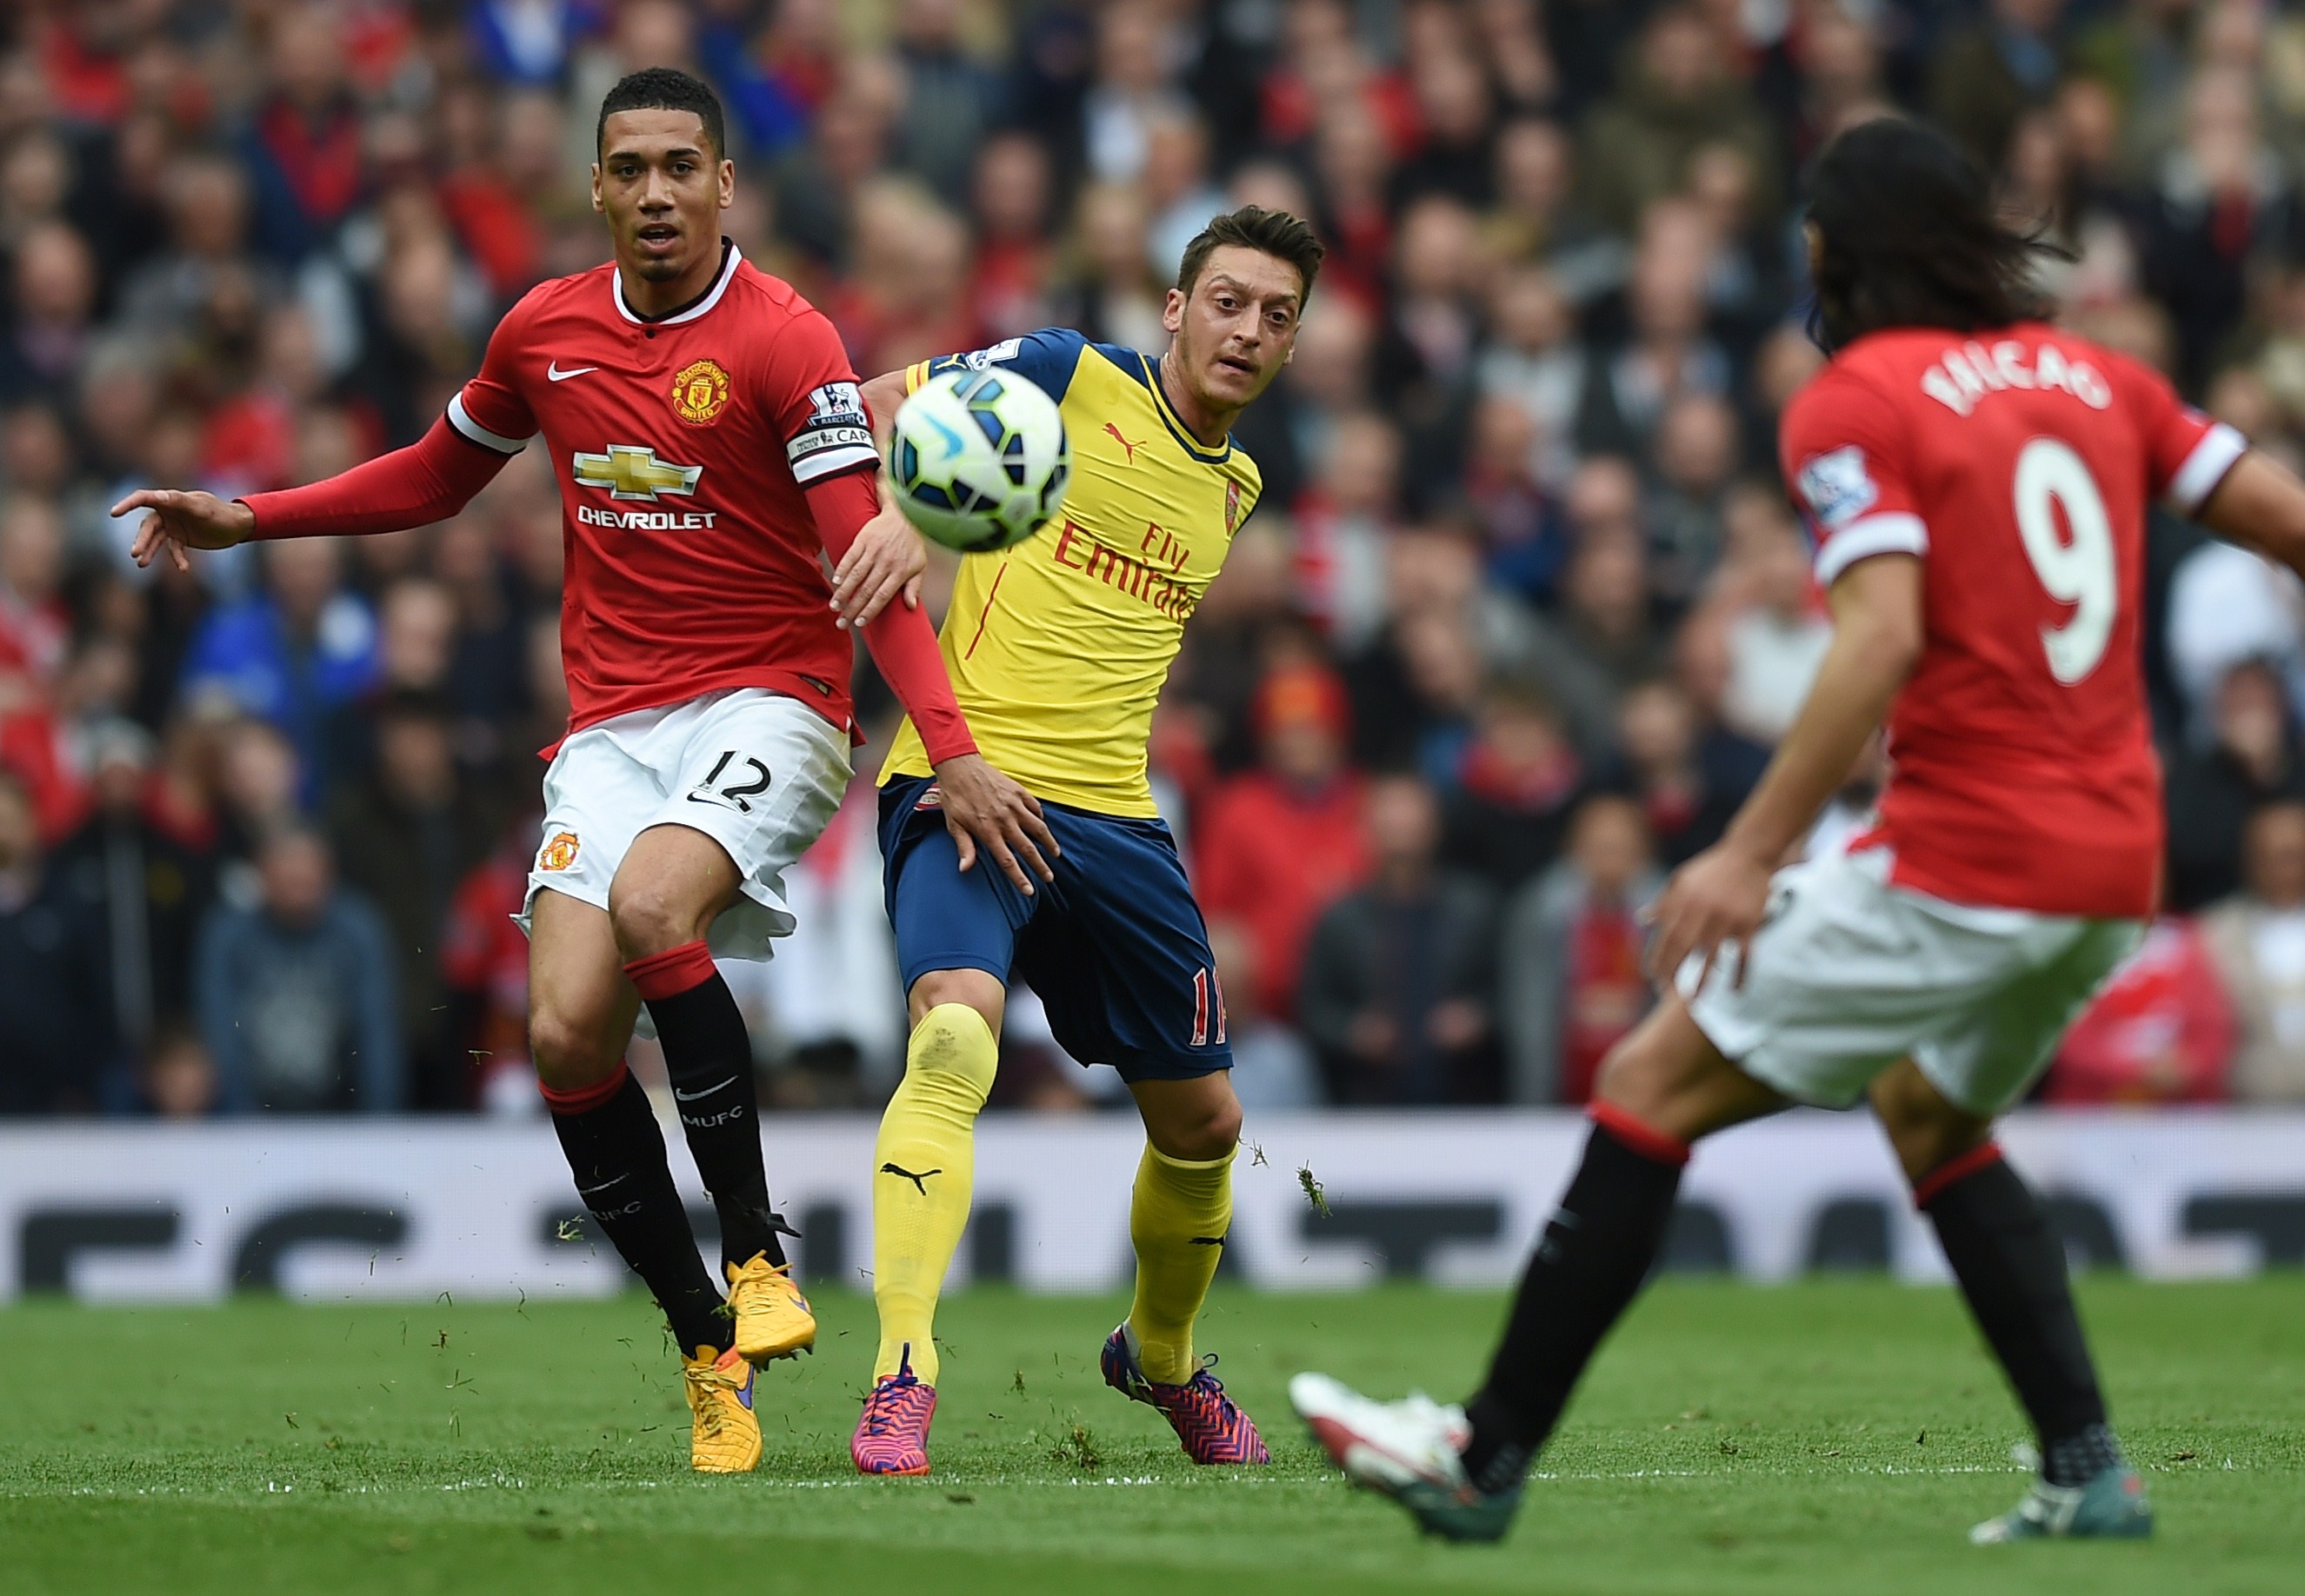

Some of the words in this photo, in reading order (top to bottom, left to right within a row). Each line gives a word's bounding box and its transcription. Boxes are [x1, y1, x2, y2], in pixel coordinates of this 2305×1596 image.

[681, 406, 714, 418] UNITED
[578, 505, 717, 530] CHEVROLET
[1140, 522, 1190, 575] Fly
[2012, 433, 2119, 687] 9
[696, 749, 772, 815] 12
[683, 1106, 743, 1127] MUFC
[591, 1200, 643, 1221] UFC
